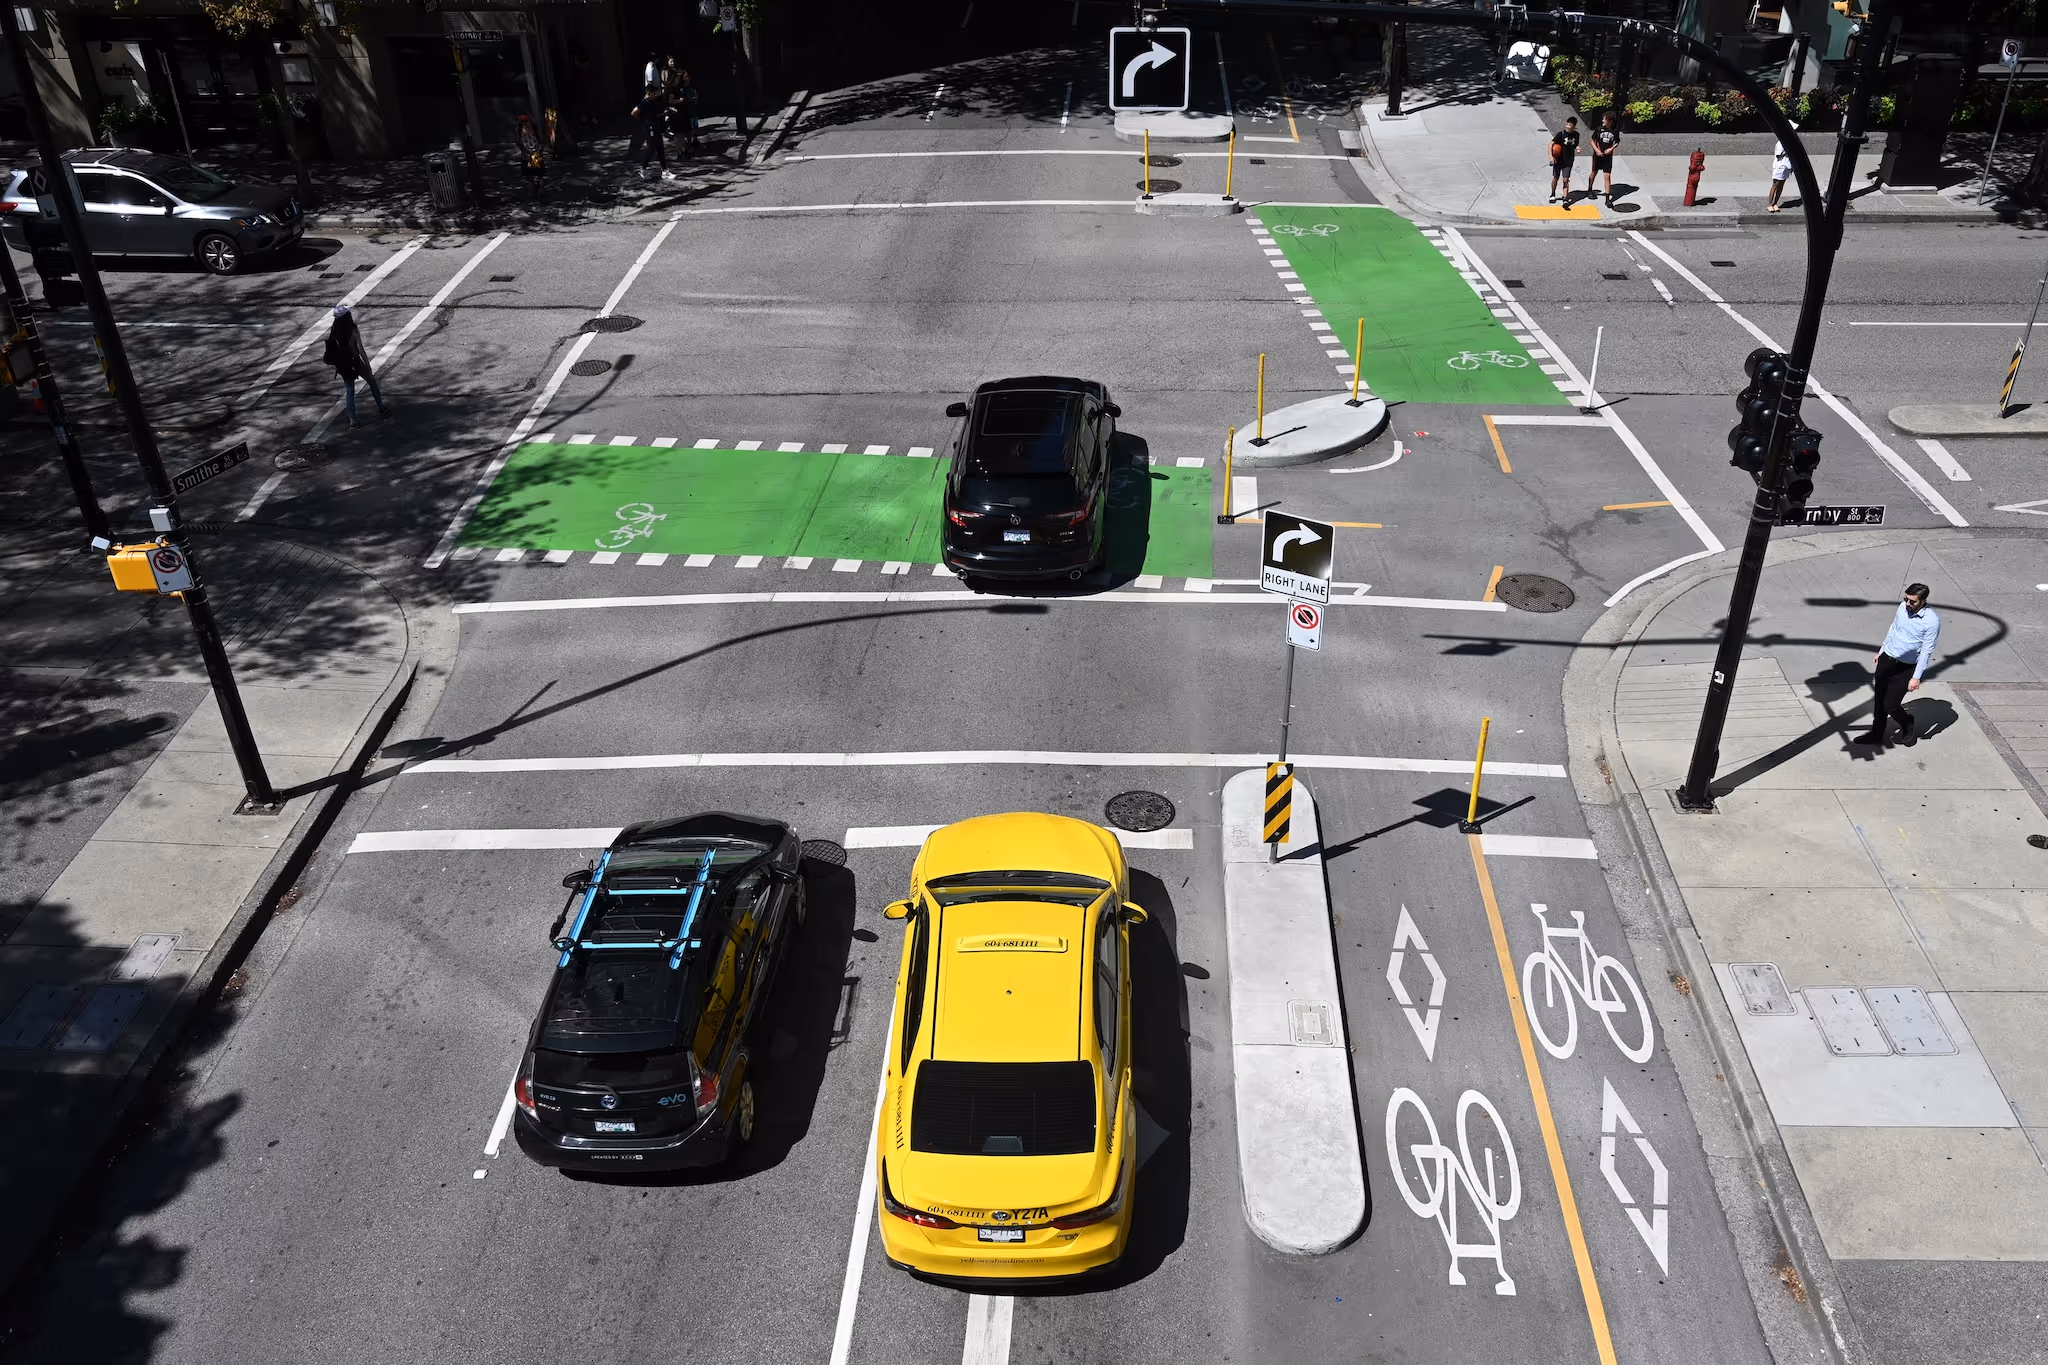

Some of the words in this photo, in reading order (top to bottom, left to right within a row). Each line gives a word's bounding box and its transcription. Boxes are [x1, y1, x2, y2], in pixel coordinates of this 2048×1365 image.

[177, 463, 220, 492] Smithe
[1806, 507, 1841, 525] rnby
[1850, 507, 1859, 515] St
[1264, 572, 1296, 589] RIGHT
[1299, 580, 1326, 597] LANE
[658, 1093, 687, 1106] evo
[1011, 1206, 1049, 1220] Y27A
